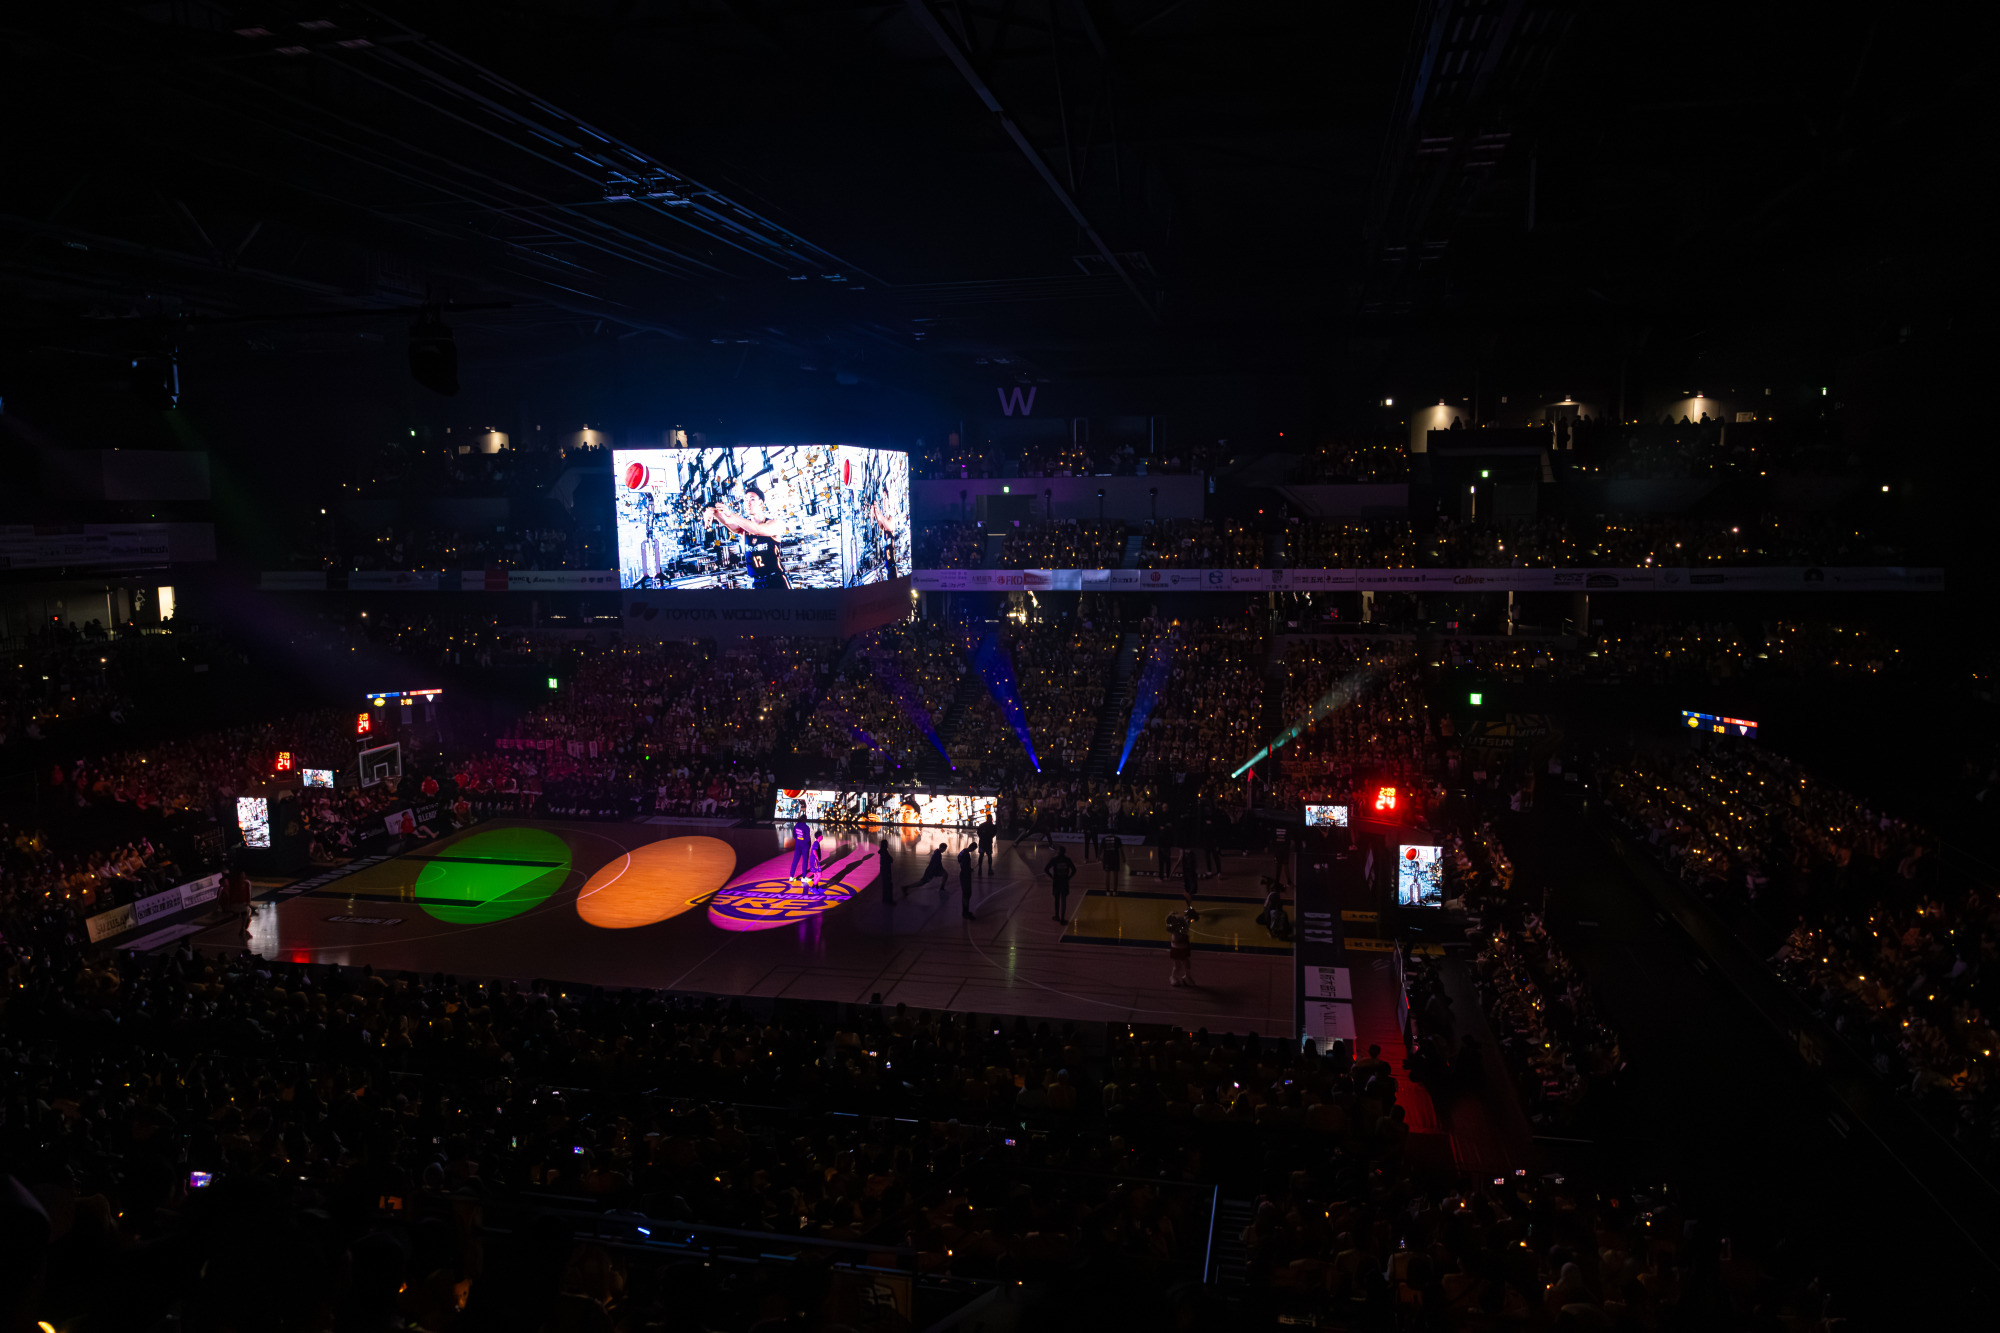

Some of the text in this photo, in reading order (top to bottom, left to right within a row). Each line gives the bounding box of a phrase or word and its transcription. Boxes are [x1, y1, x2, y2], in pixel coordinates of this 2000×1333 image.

[997, 387, 1037, 417] W
[1006, 576, 1023, 585] FKD
[1453, 575, 1485, 585] Calbee
[666, 608, 717, 620] TOYOTA
[795, 608, 837, 621] HOME
[358, 721, 369, 733] 24
[277, 759, 290, 770] 24
[1379, 787, 1396, 796] 2:09
[1376, 795, 1396, 810] 24
